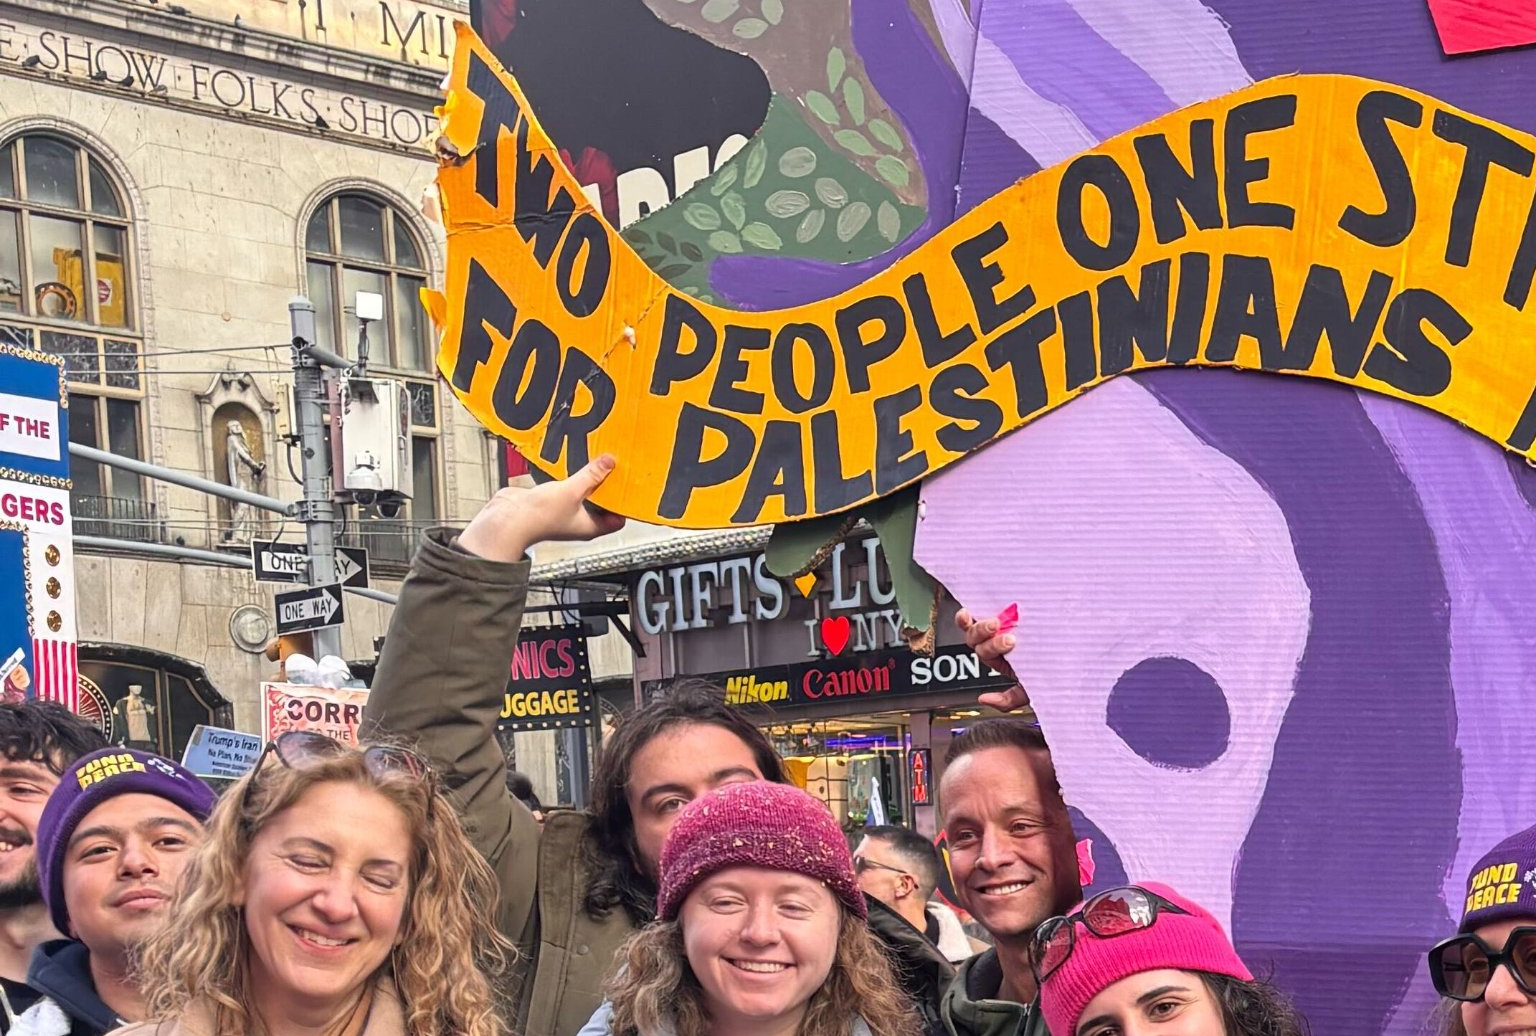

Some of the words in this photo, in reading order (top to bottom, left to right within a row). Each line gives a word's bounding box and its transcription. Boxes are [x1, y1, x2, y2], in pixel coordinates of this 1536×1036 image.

[38, 31, 168, 90] SHOW
[190, 63, 321, 124] FOLKS
[467, 51, 609, 319] TWO
[650, 221, 1037, 415] PEOPLE
[1056, 94, 1298, 272] ONE
[452, 257, 615, 476] FOR
[657, 251, 1474, 524] PALESTINIANS
[14, 415, 51, 440] THE
[1, 493, 65, 527] GERS
[271, 555, 305, 572] ONE
[285, 603, 305, 620] ONE
[312, 597, 332, 616] WAY
[636, 554, 784, 635] GIFTS
[852, 609, 911, 652] NY
[511, 638, 575, 681] NICS
[724, 674, 790, 705] Nikon
[802, 665, 891, 700] Canon
[910, 652, 1002, 686] SON
[287, 699, 360, 725] CORR
[208, 732, 240, 749] Trump's
[241, 738, 258, 751] Iran
[326, 729, 350, 741] THE
[912, 751, 927, 804] ATM
[1471, 862, 1519, 893] FUND
[1465, 883, 1523, 915] PEACE
